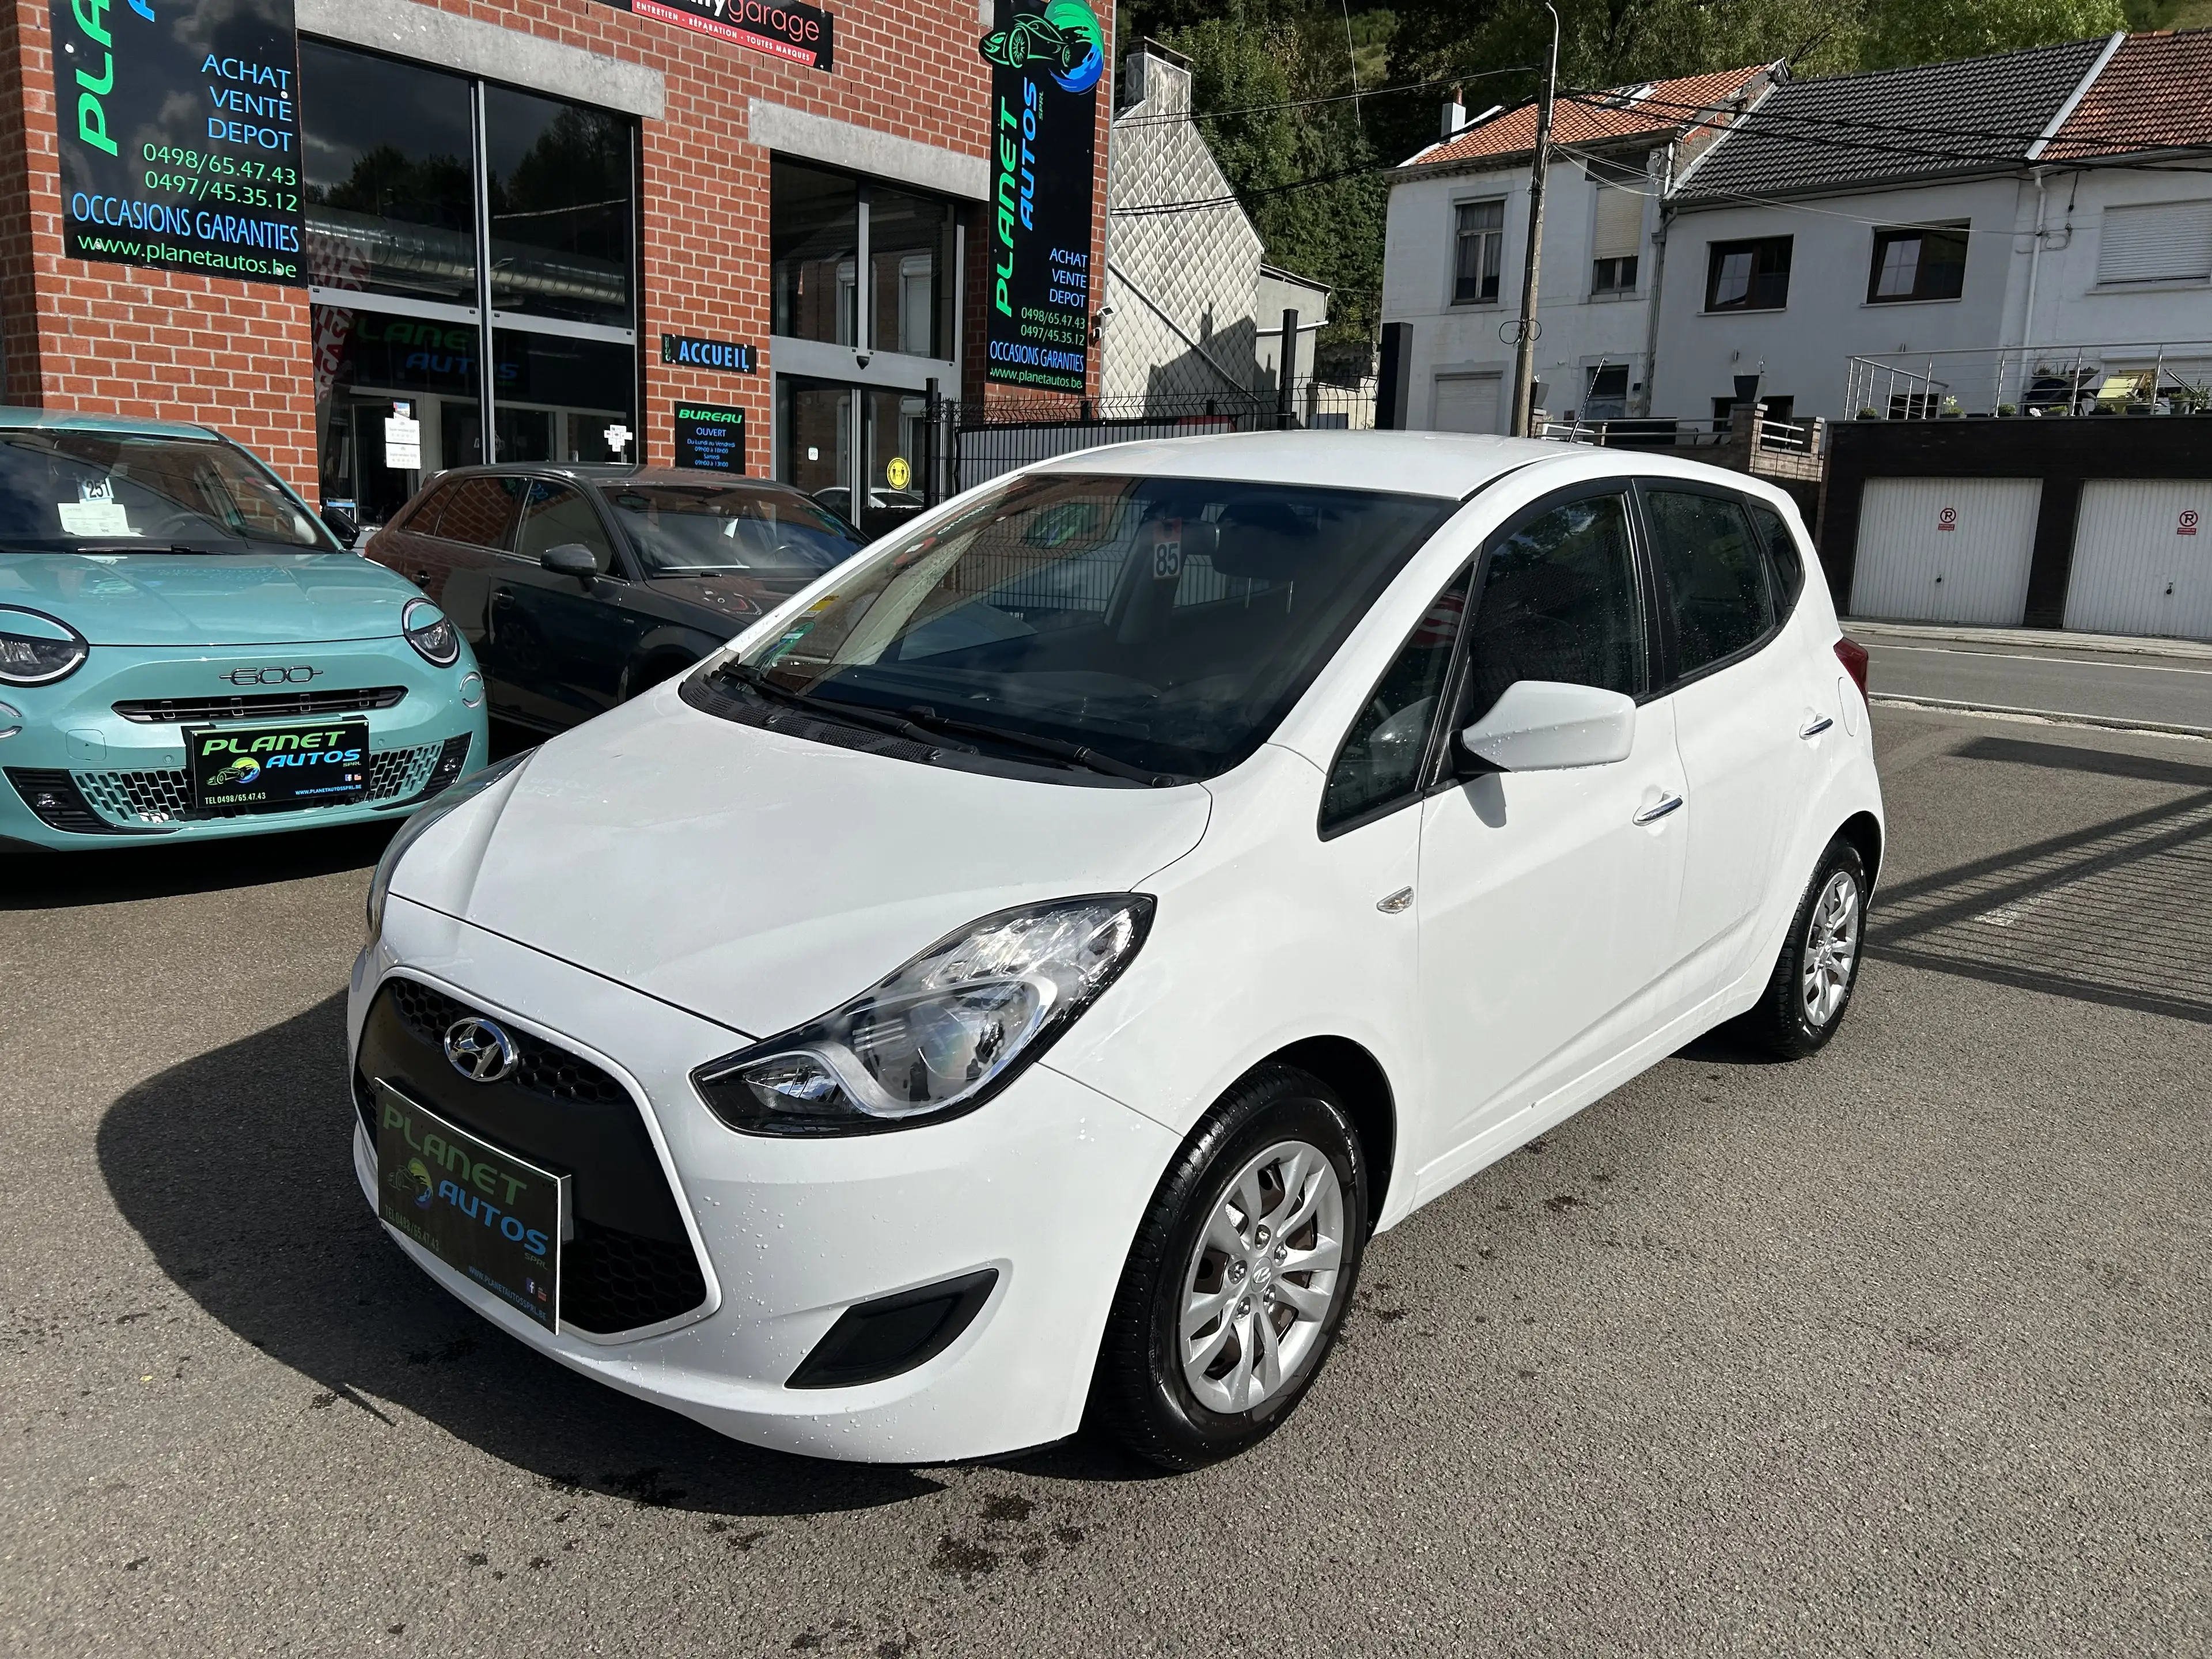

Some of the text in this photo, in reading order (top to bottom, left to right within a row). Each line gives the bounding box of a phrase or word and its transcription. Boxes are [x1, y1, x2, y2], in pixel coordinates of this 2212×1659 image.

[636, 1, 679, 21] ENTRETIEN
[688, 17, 737, 39] RÉPARATION
[747, 35, 773, 50] TOUTES
[776, 44, 810, 62] MARQUES
[201, 54, 291, 90] ACHAT
[210, 86, 293, 122] VENTE
[207, 117, 293, 152] DEPOT
[143, 143, 297, 186] 0498/65.47.43
[1020, 76, 1037, 231] AUTOS
[145, 171, 298, 212] 0497/45.35.12
[996, 96, 1017, 317] PLANET
[71, 192, 299, 253] OCCASIONS GARANTIES
[77, 234, 297, 278] www.planetautos.be
[1049, 248, 1088, 269] ACHAT
[1052, 267, 1088, 289] VENTE
[1049, 288, 1086, 308] DEPOT
[1021, 306, 1086, 330] 0498/65.47.43
[1020, 324, 1085, 346] 0497/45.35.12
[679, 340, 749, 369] ACCUEIL
[990, 340, 1084, 373] OCCASIONS GARANTIES
[991, 366, 1083, 389] www.planetautos.be
[679, 409, 743, 424] BUREAU
[696, 427, 726, 437] OUVERT
[1156, 542, 1180, 576] 85
[227, 665, 317, 685] 600
[202, 731, 346, 756] PLANET
[266, 748, 362, 768] AUTOS
[295, 785, 362, 795] WWW.PLANETAUTOSSPRL.BE
[382, 1103, 528, 1206] PLANET
[437, 1179, 549, 1256] AUTOS
[524, 1251, 550, 1271] SPRL
